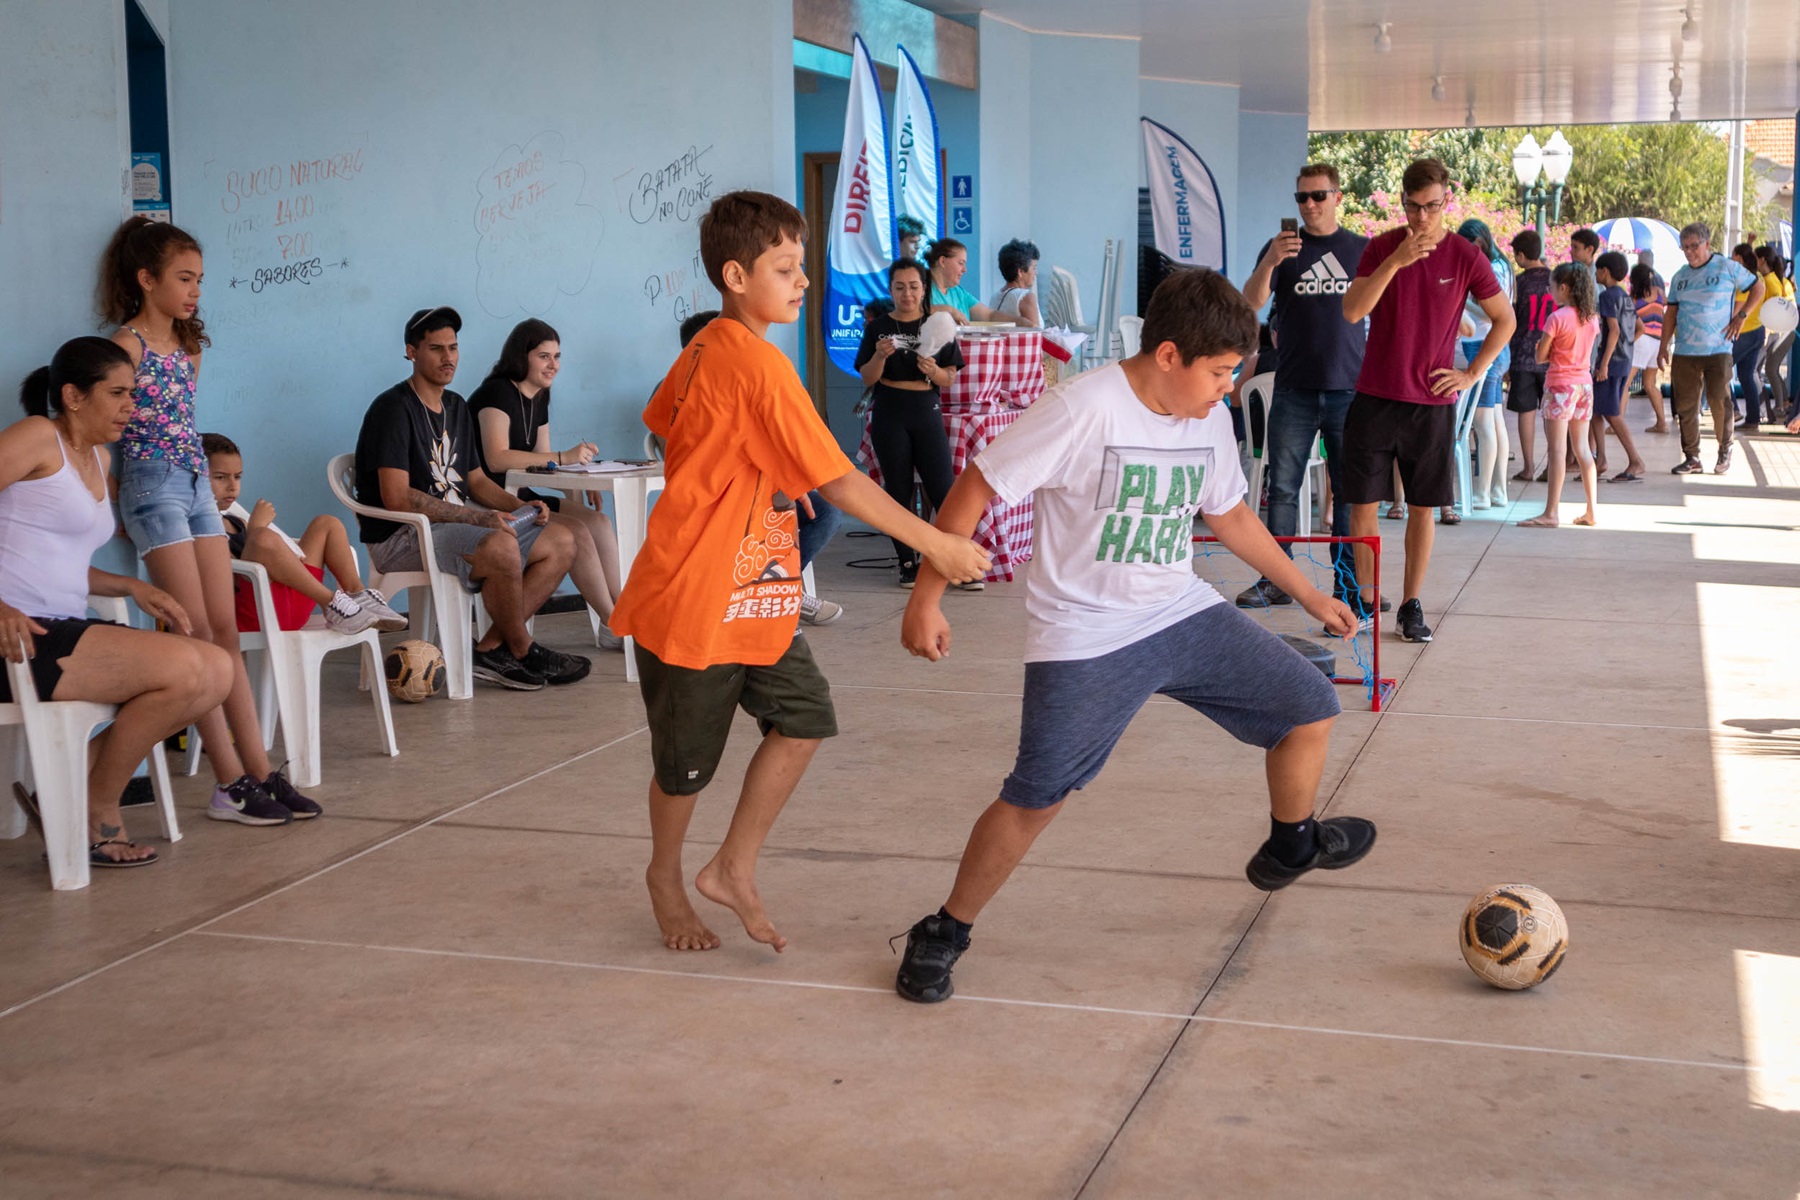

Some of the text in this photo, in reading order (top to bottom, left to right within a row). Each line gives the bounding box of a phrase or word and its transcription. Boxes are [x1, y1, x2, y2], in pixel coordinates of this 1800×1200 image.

[221, 149, 364, 214] SUCO NATURAL
[493, 151, 543, 190] TEMOS
[629, 145, 713, 224] BATATA
[480, 180, 557, 232] CERVEJA
[659, 175, 713, 222] NO CONE
[1166, 146, 1192, 258] ENFERMAGEM
[1529, 293, 1559, 331] 10
[1117, 464, 1205, 515] PLAY
[756, 584, 799, 597] SHADOW
